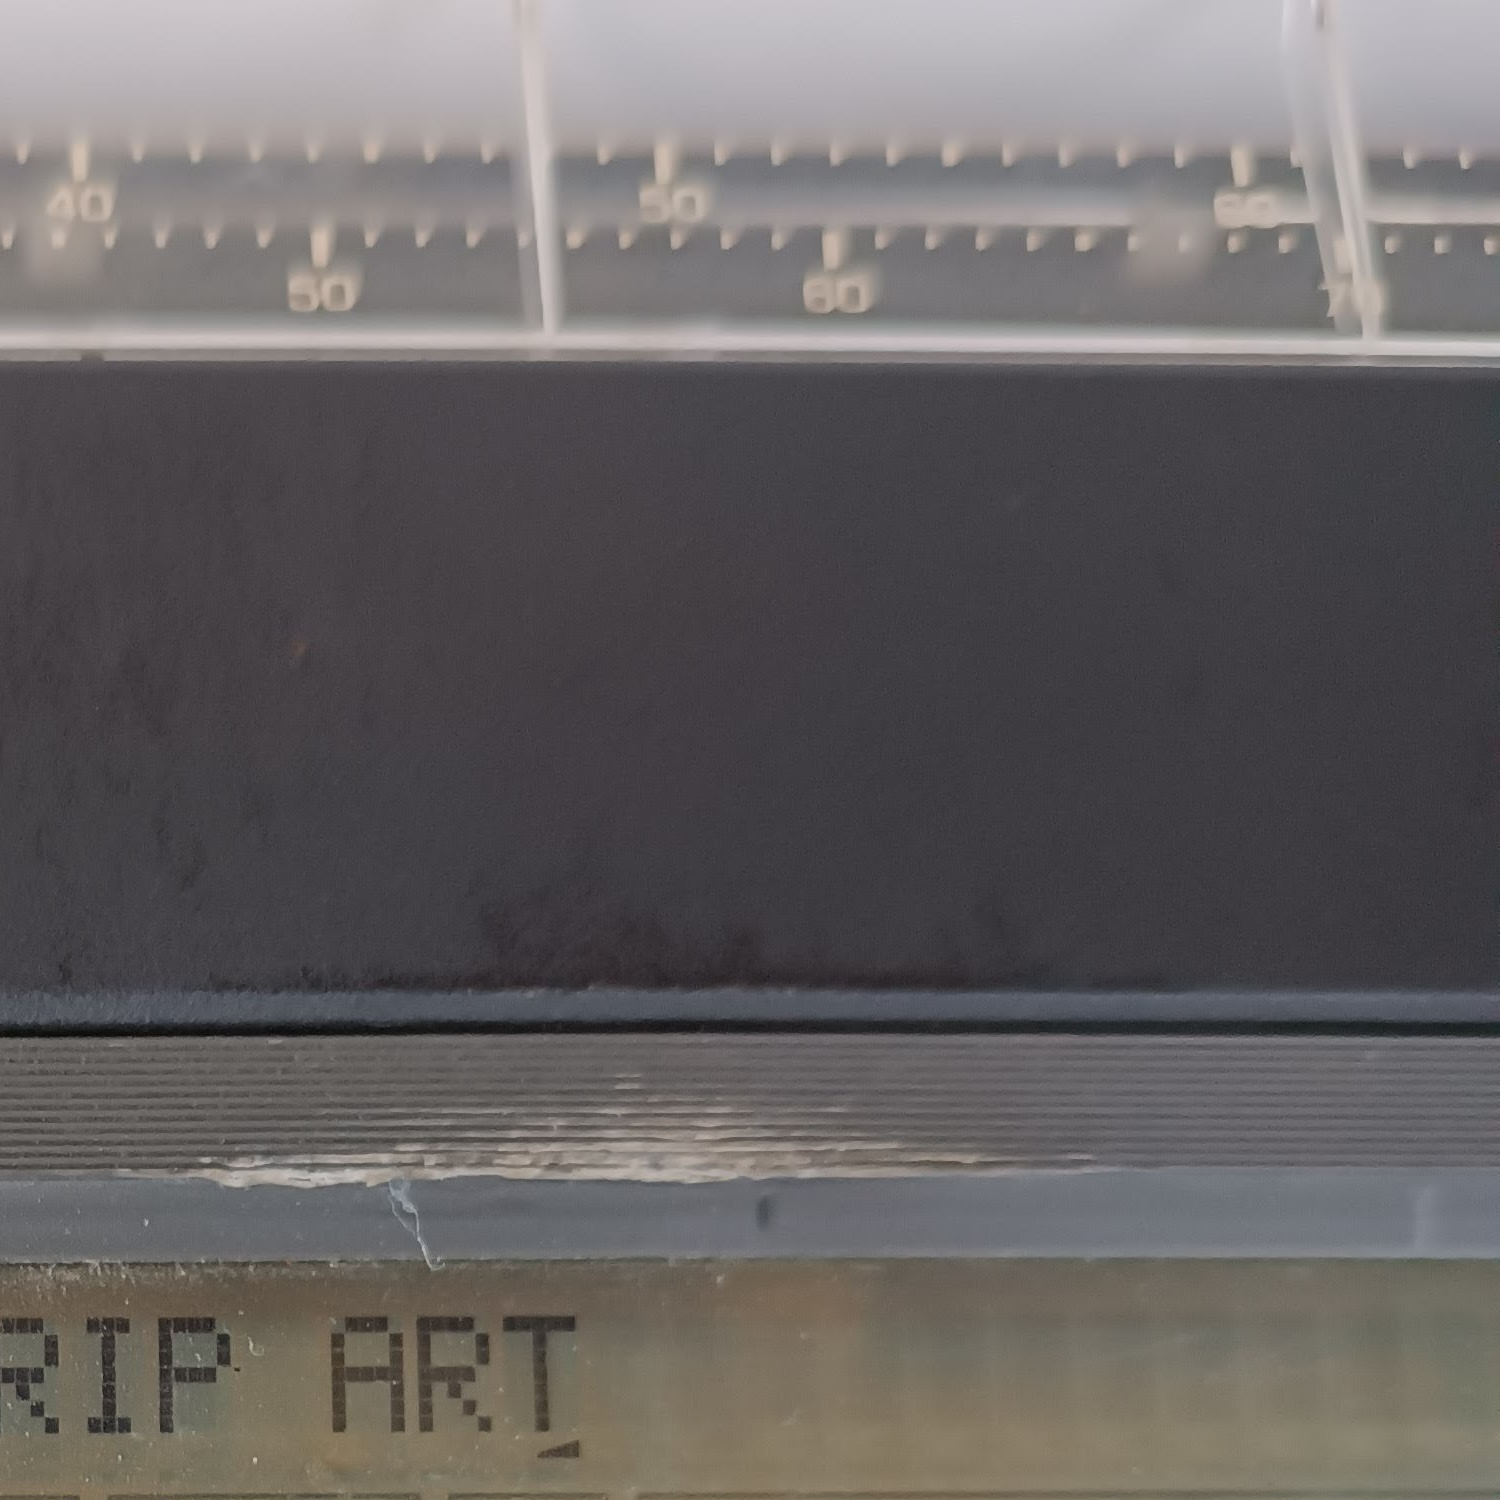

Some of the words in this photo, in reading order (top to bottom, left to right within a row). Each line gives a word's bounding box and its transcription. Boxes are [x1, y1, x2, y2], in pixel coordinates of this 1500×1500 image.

[46, 184, 114, 222] 40
[802, 275, 874, 313] 60
[330, 1315, 576, 1433] ART
